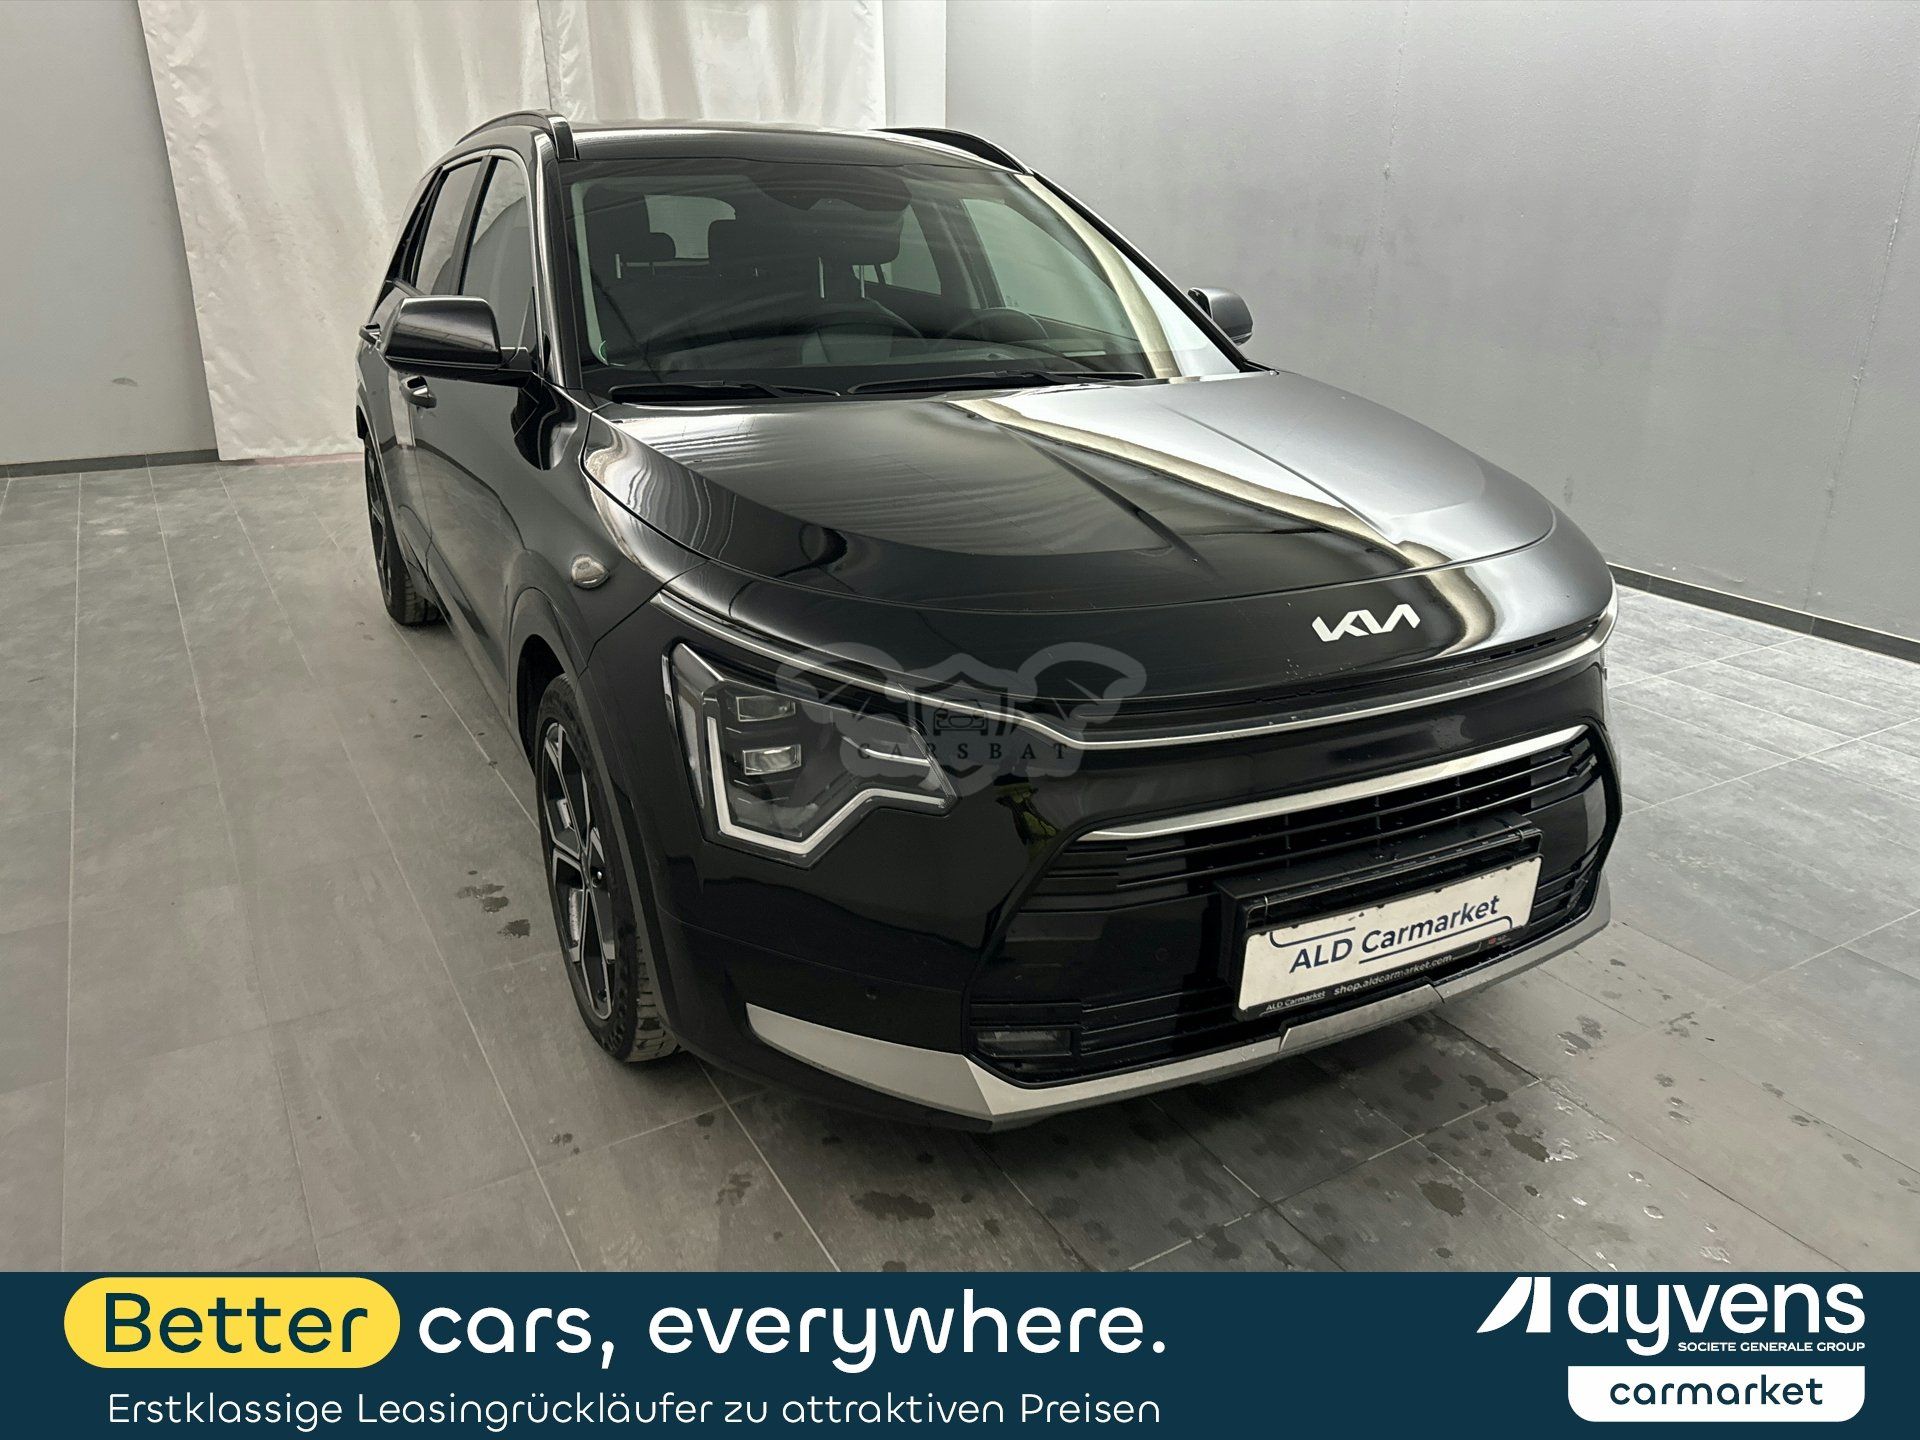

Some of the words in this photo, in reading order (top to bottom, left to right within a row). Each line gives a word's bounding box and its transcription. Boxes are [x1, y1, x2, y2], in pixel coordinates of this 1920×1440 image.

[1311, 604, 1420, 641] KIA
[1288, 938, 1353, 974] ALD
[1361, 895, 1501, 954] Carmarket
[1333, 954, 1453, 996] shop.aldcarmarket.com
[1265, 1000, 1284, 1012] ALD
[1284, 990, 1326, 1008] Carmarket
